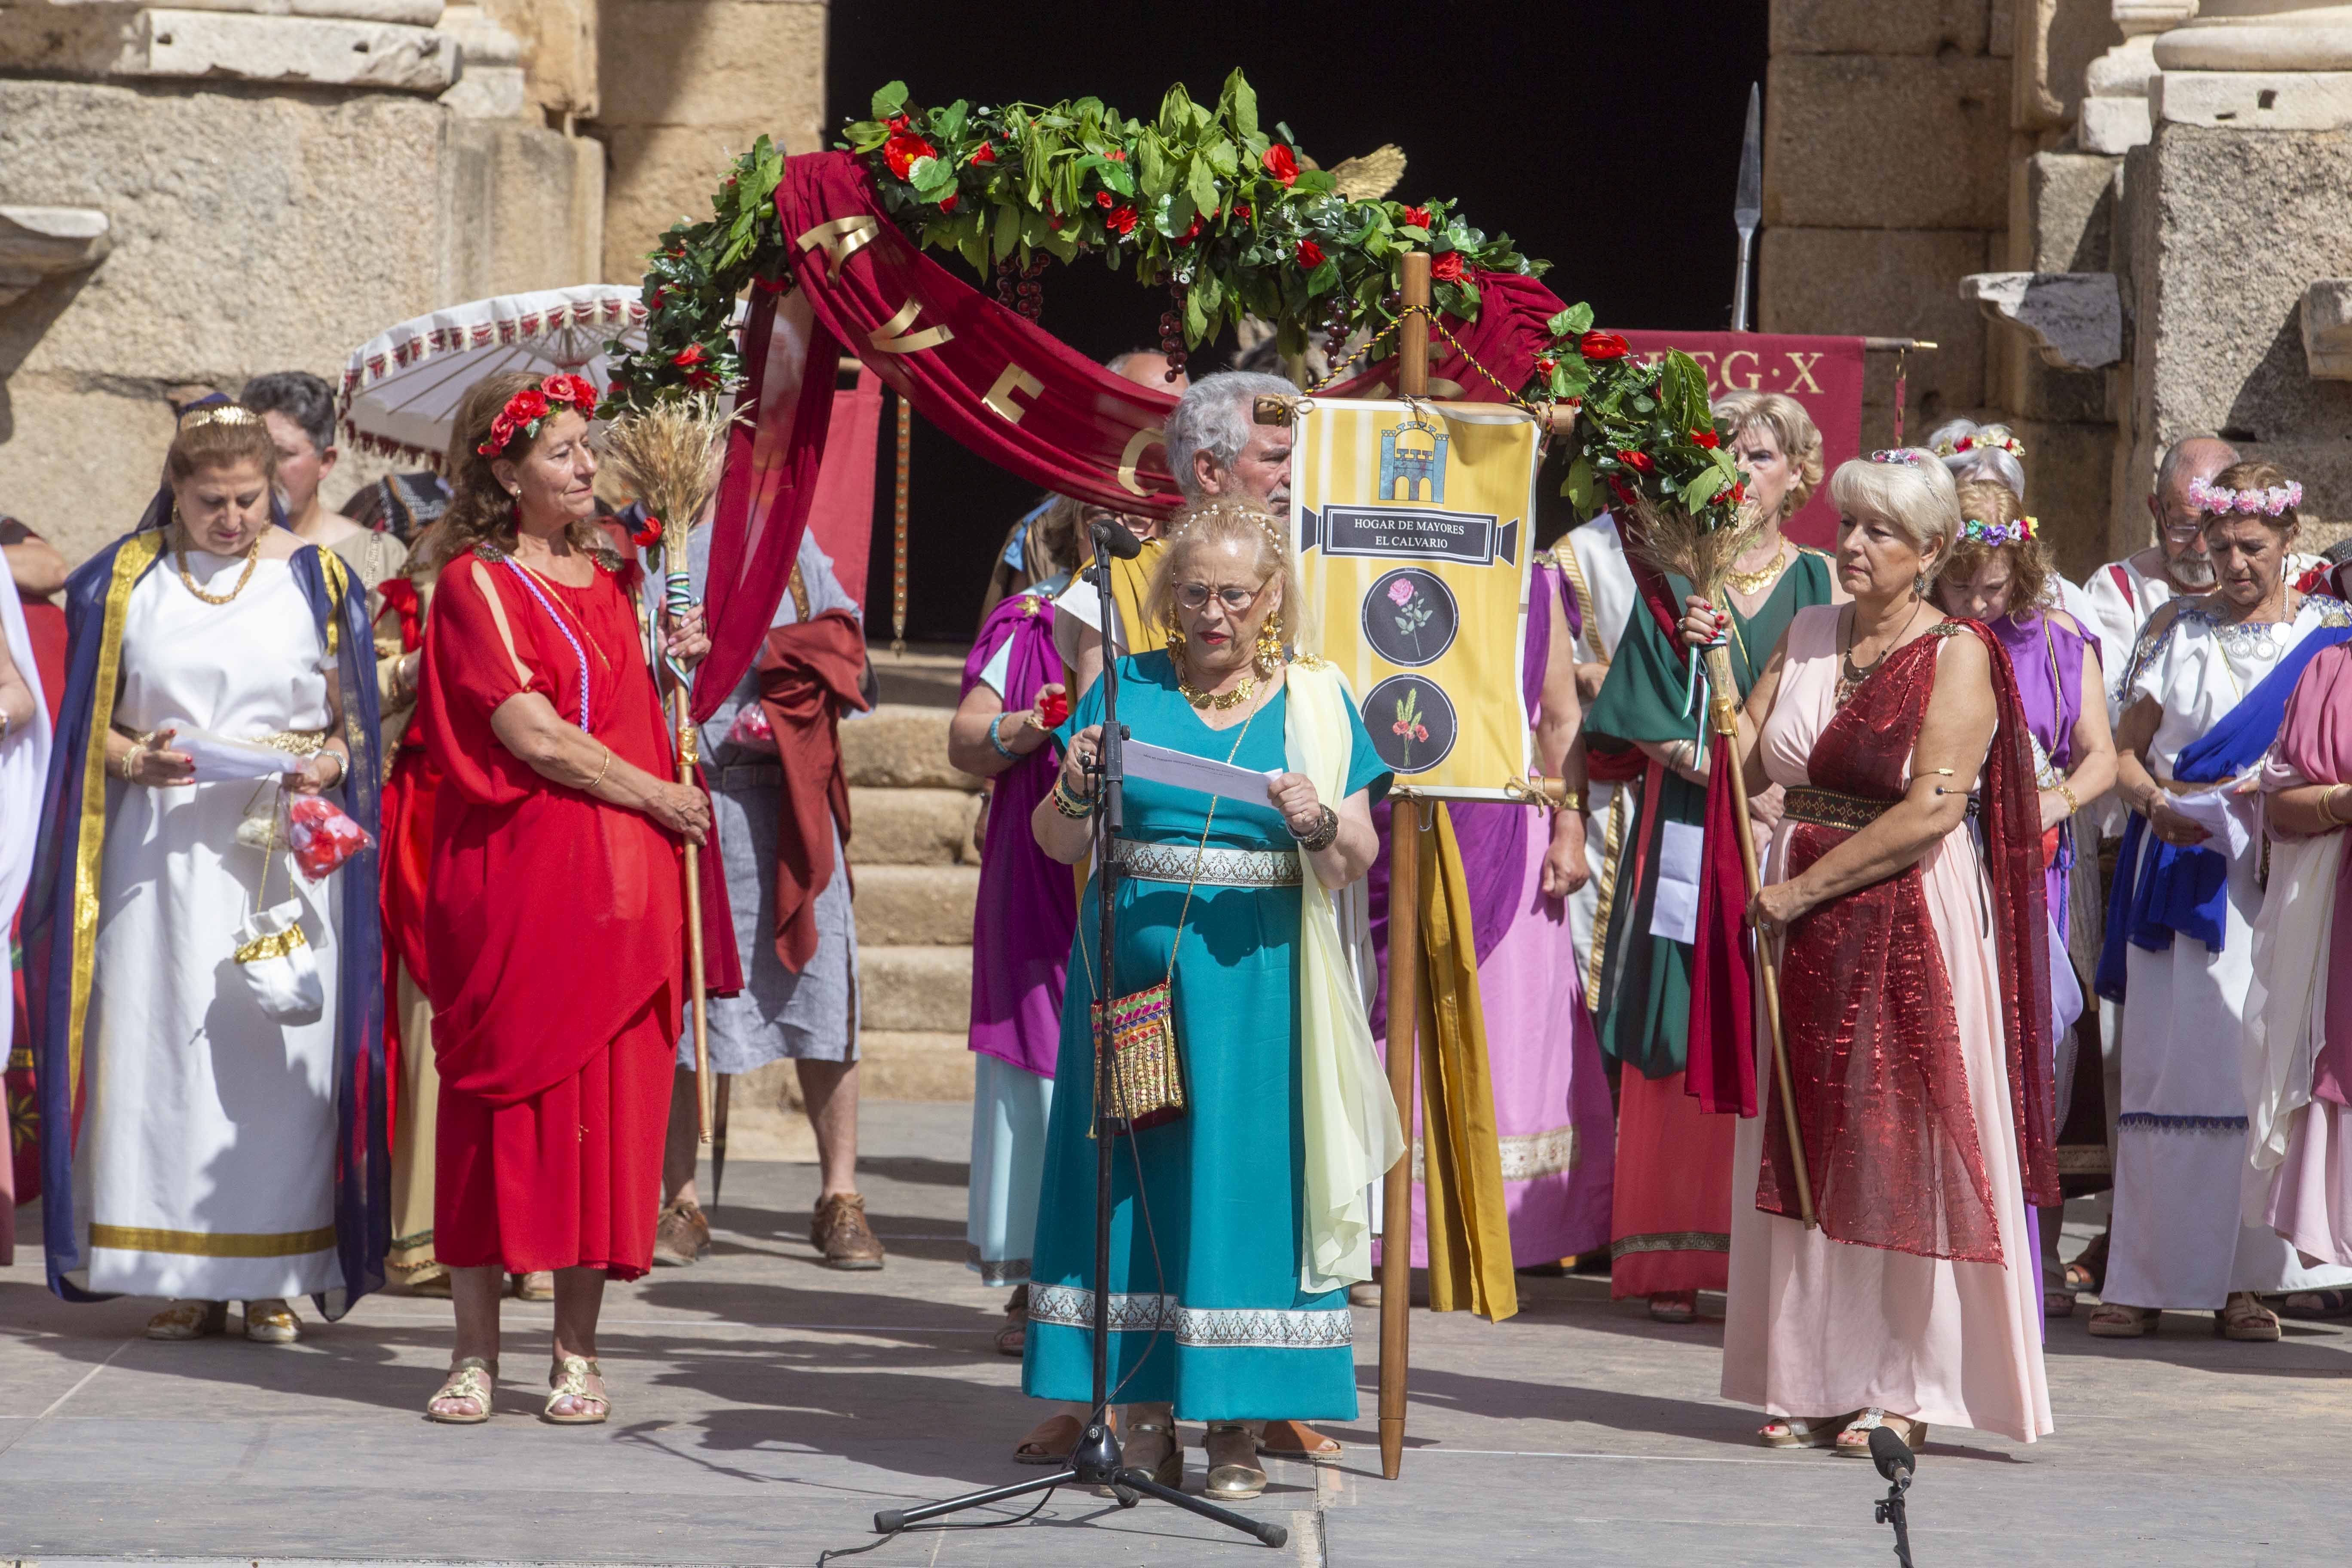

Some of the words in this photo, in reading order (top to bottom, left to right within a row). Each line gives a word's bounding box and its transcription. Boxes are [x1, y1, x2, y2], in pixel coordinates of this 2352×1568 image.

[1354, 518, 1396, 530] HOGAR
[1398, 521, 1414, 530] DE
[1416, 521, 1464, 535] MAYORES
[1375, 536, 1390, 546] EL
[1392, 536, 1448, 548] CALVARIO
